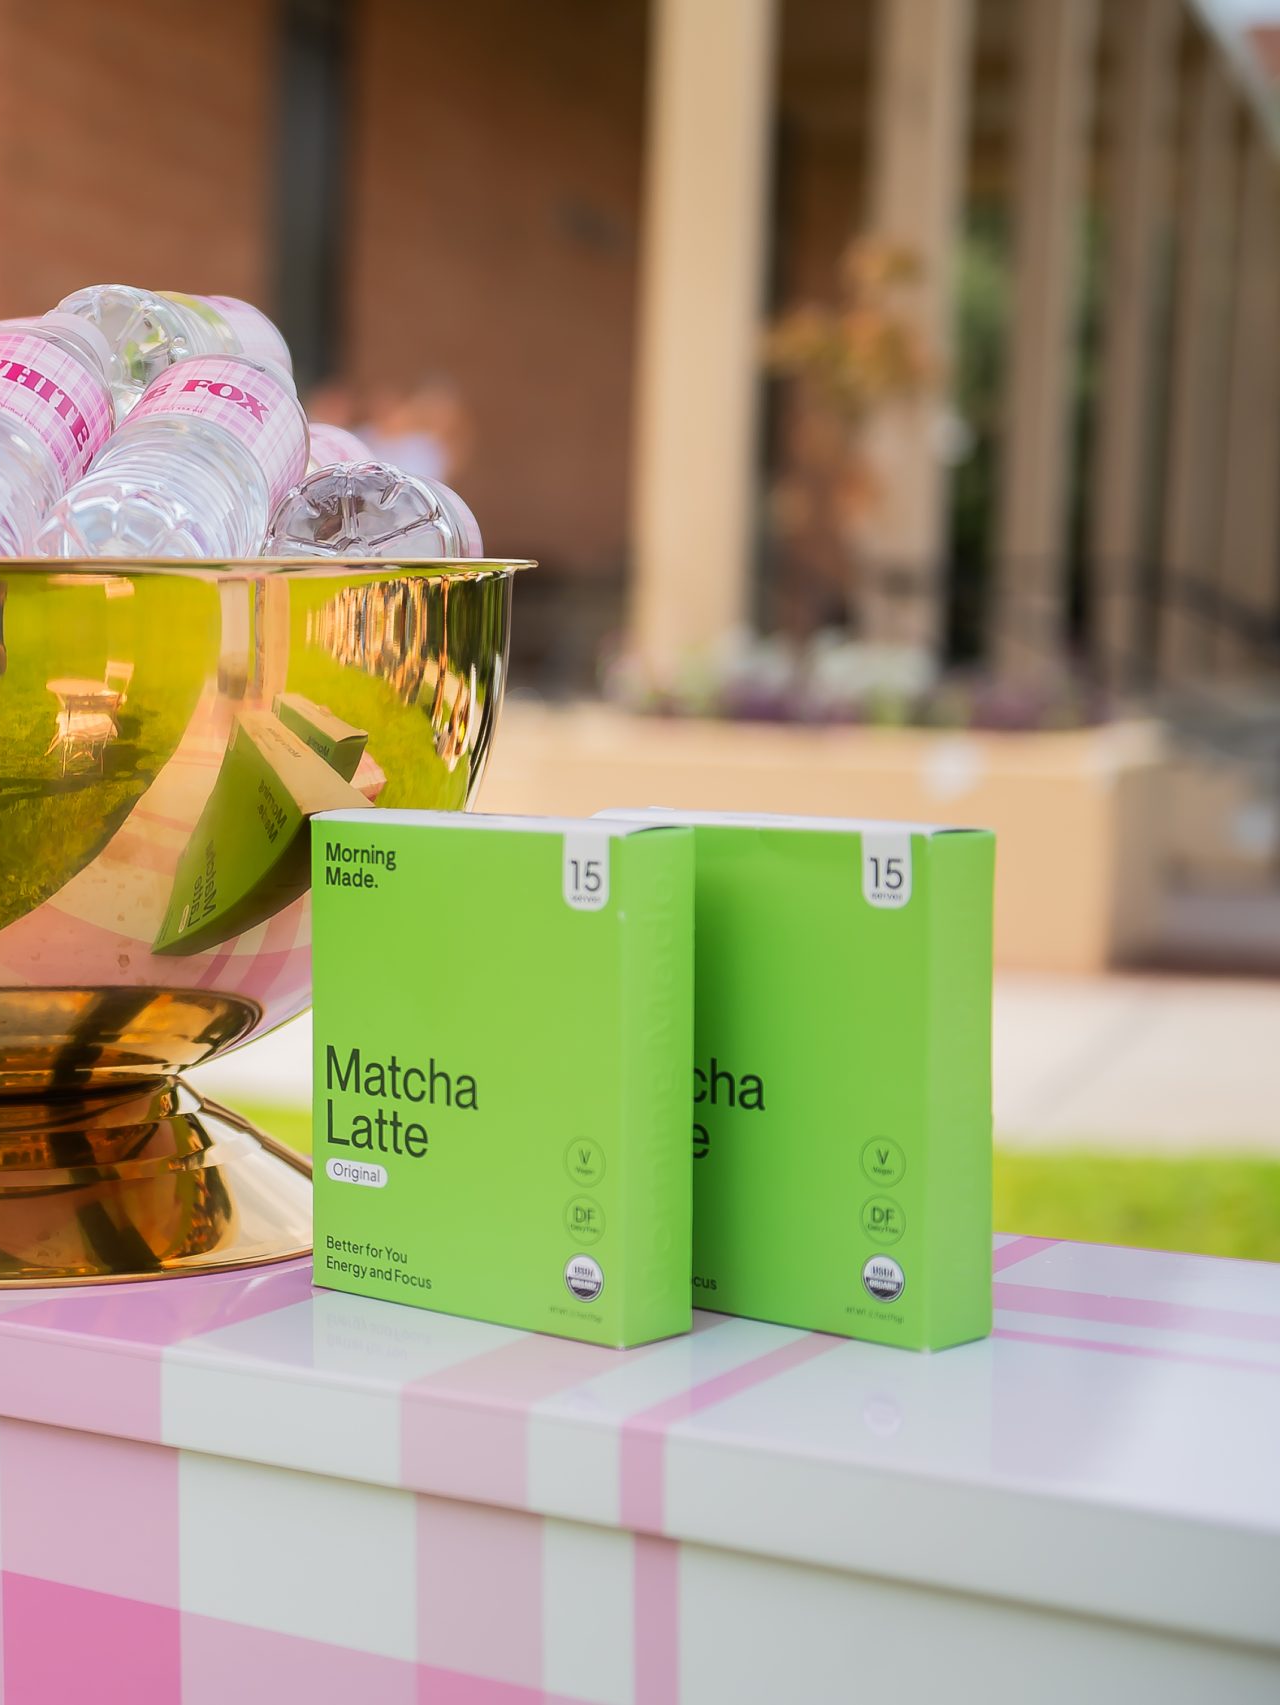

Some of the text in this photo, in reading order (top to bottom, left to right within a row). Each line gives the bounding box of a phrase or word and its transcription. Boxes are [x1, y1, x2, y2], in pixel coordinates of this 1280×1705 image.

[179, 379, 269, 424] FOX
[325, 842, 397, 870] Morning
[325, 867, 379, 888] Made.
[570, 860, 602, 892] 15
[869, 857, 903, 889] 15
[324, 1043, 479, 1111] Matcha
[693, 1056, 766, 1111] cha
[325, 1098, 430, 1159] Latte
[578, 1149, 592, 1165] V
[877, 1149, 889, 1166] V
[332, 1162, 380, 1183] Original
[574, 1205, 595, 1225] DF
[871, 1206, 896, 1226] DF
[326, 1235, 408, 1264] Better for You
[326, 1255, 433, 1290] Energy and Focus
[693, 1275, 718, 1290] cus
